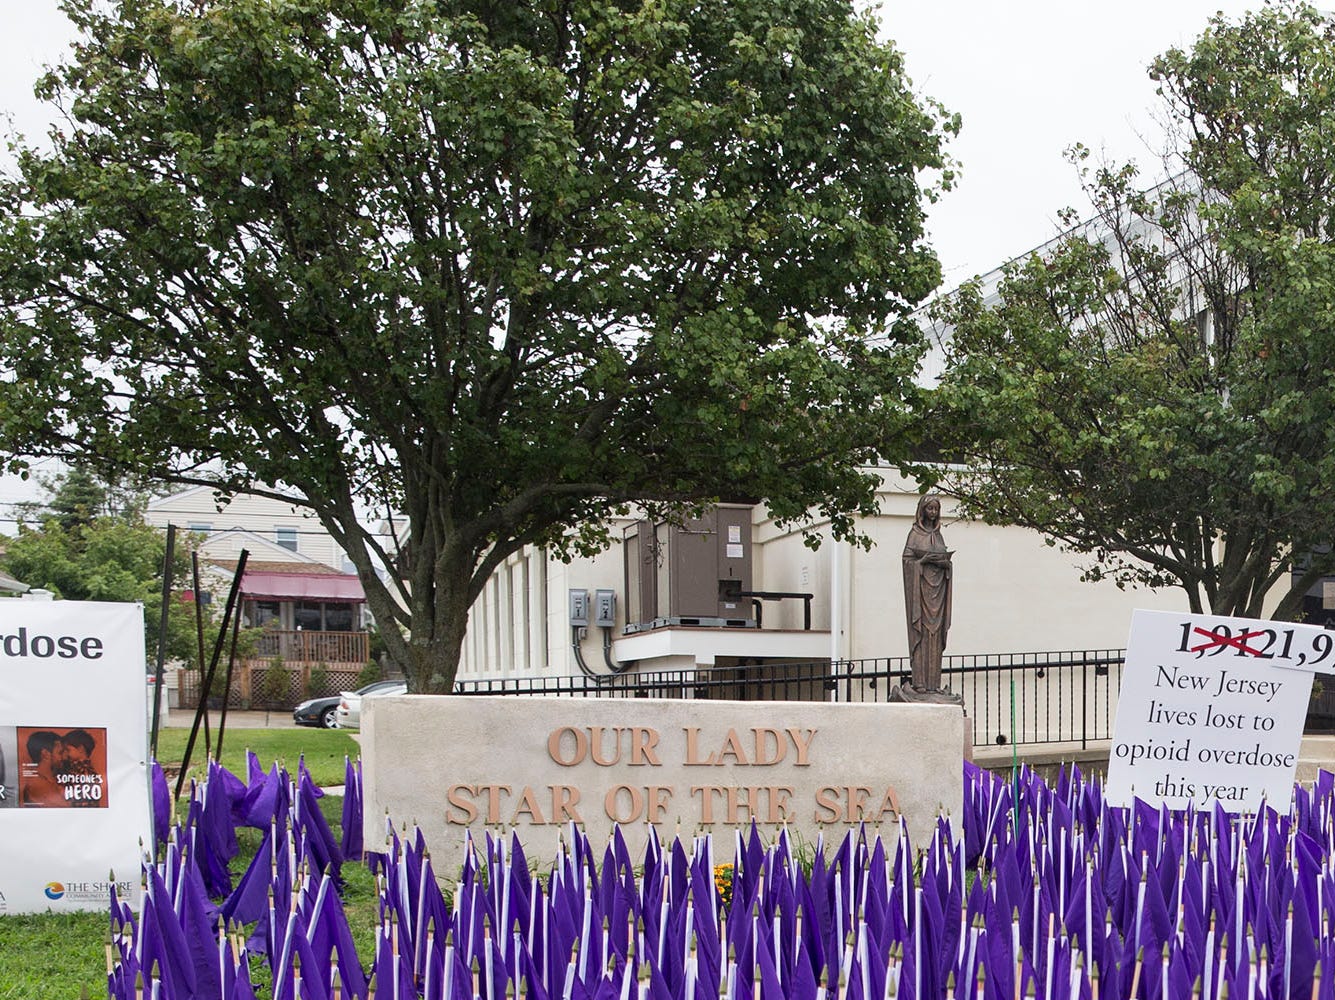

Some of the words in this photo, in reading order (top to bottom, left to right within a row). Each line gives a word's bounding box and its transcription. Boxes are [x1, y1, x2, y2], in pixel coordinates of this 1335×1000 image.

[0, 627, 104, 659] dose
[1154, 665, 1211, 691] New
[1213, 670, 1282, 702] Jersey
[1148, 701, 1197, 727] lives
[1205, 705, 1245, 730] lost
[1253, 714, 1275, 732] to
[547, 726, 662, 767] OUR
[682, 727, 818, 767] LADY
[1115, 739, 1191, 766] opioid
[1198, 744, 1295, 768] overdose
[56, 774, 103, 784] SOMEONE'S
[64, 784, 102, 800] HERO
[1155, 774, 1197, 799] this
[1201, 783, 1249, 806] year
[446, 783, 586, 826] STAR
[604, 784, 676, 825] OF
[691, 785, 796, 825] THE
[814, 785, 903, 825] SEA
[66, 882, 90, 892] THE
